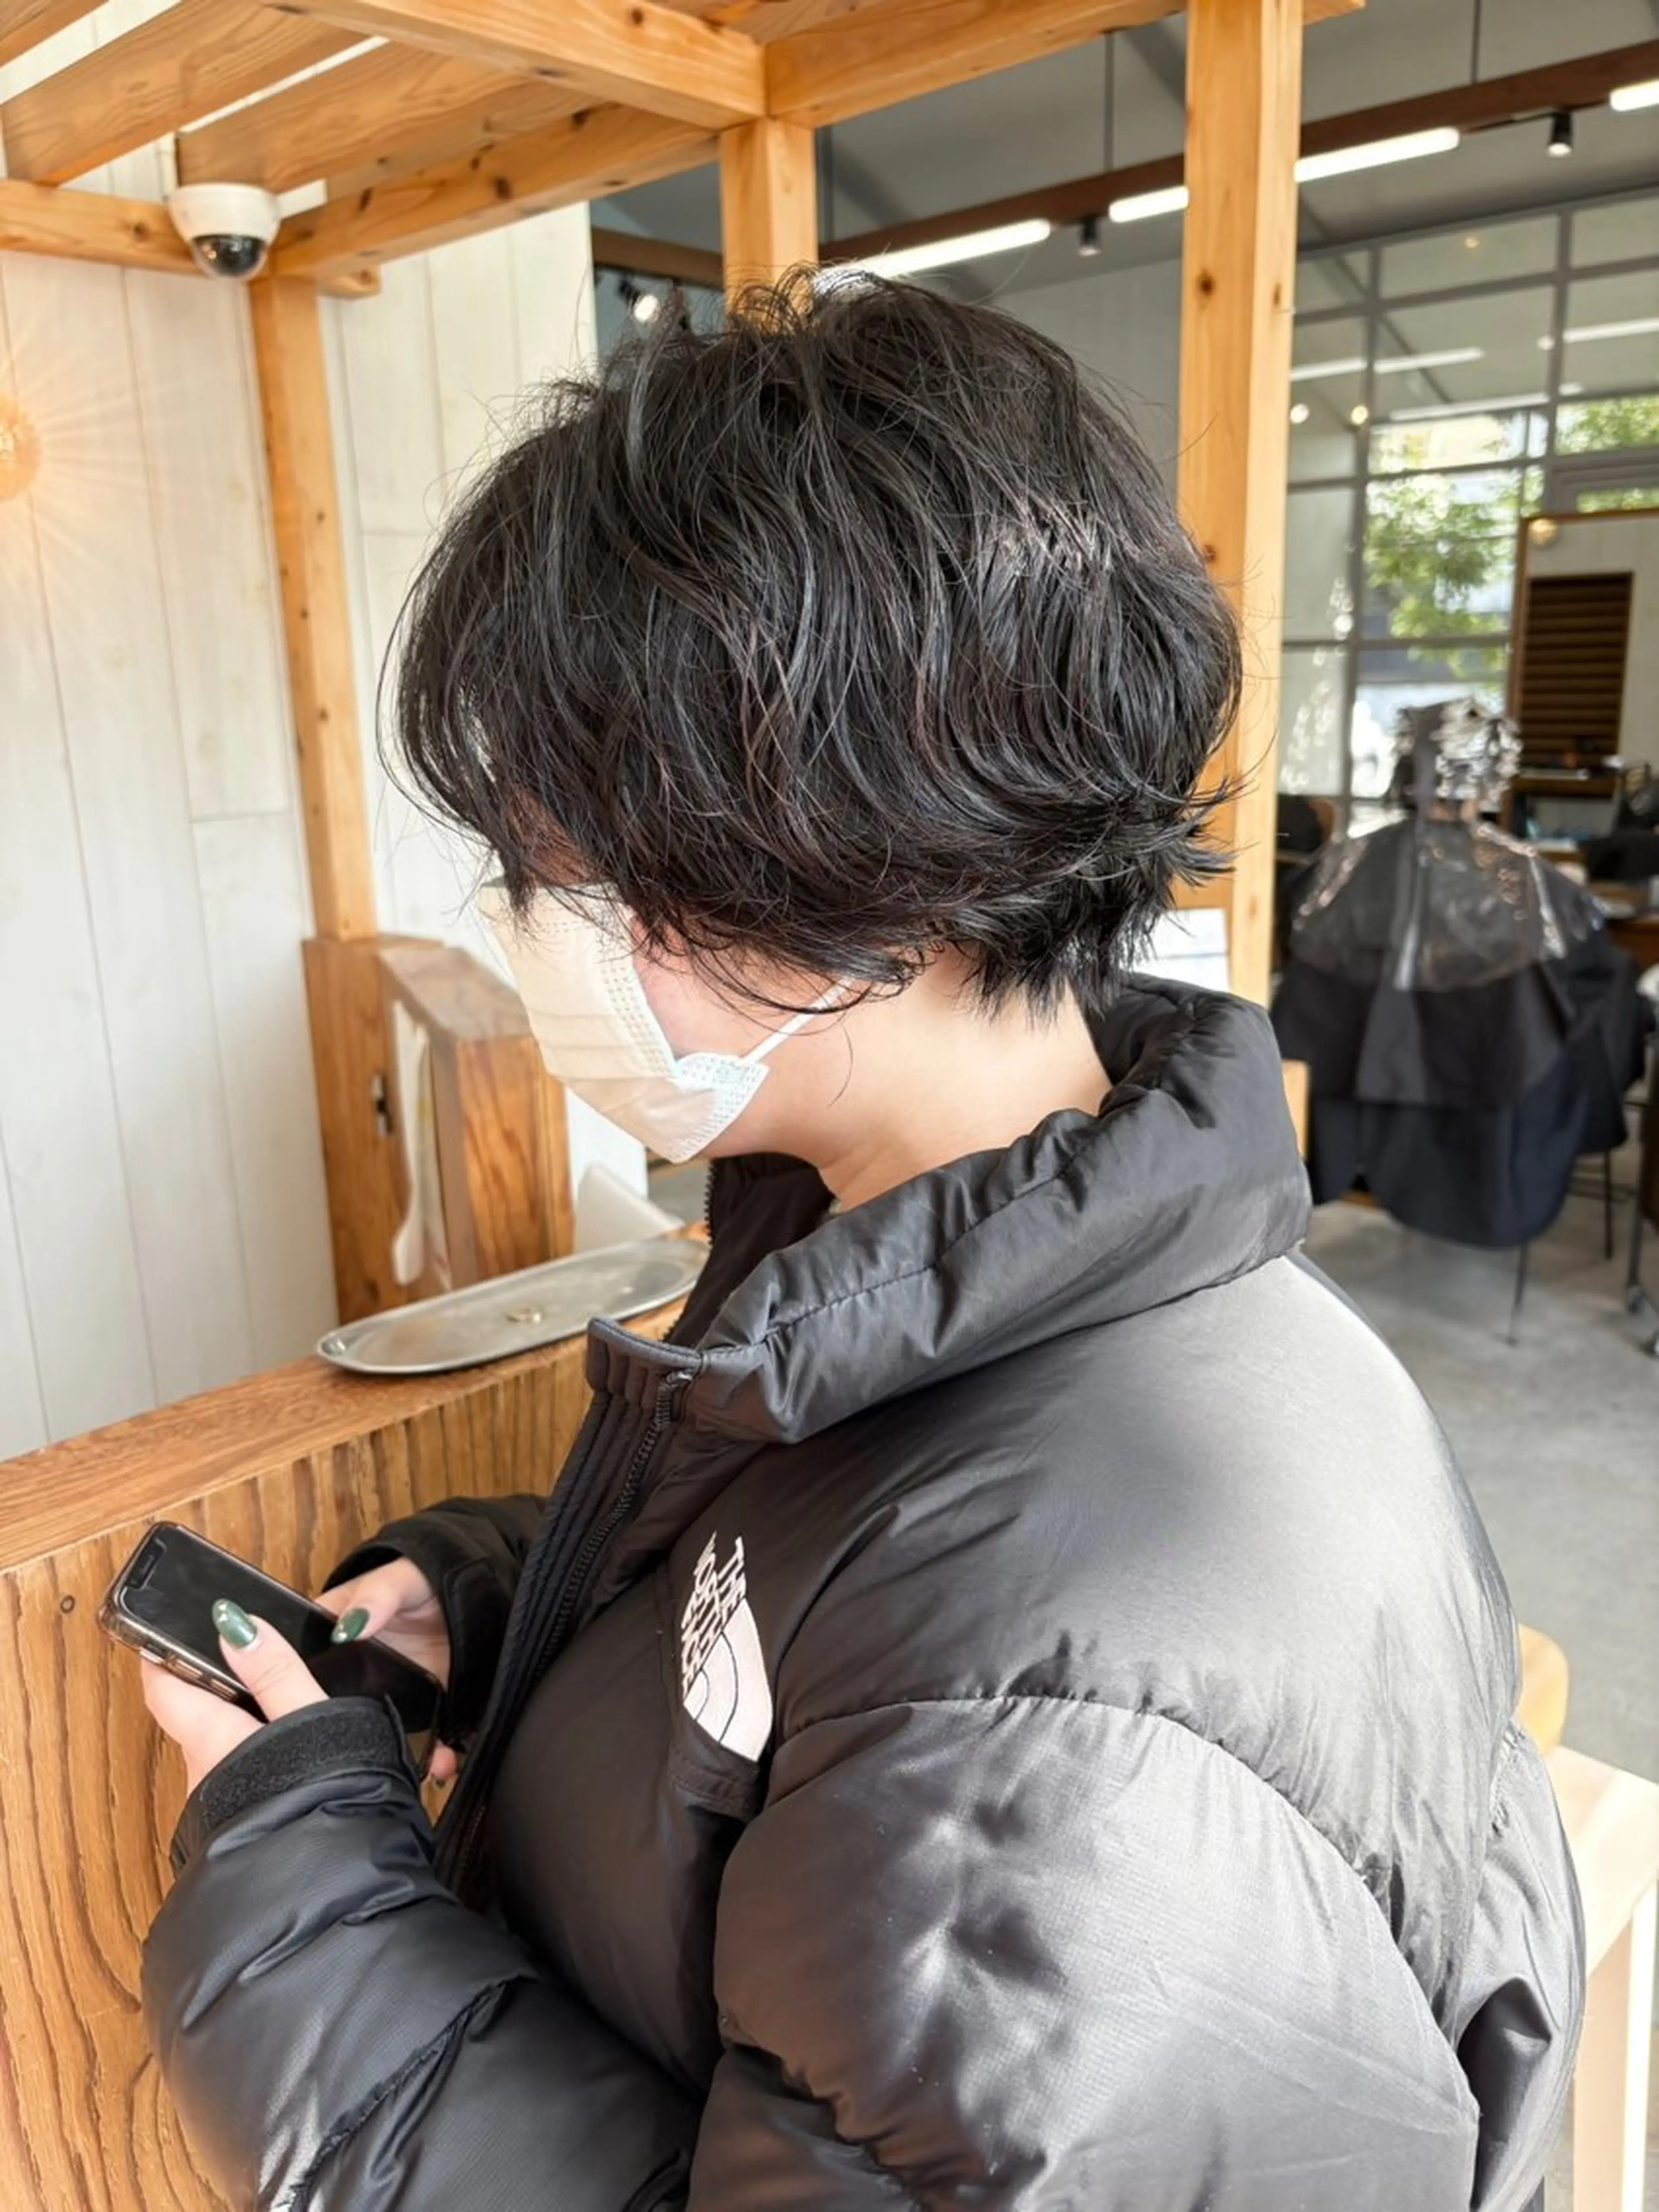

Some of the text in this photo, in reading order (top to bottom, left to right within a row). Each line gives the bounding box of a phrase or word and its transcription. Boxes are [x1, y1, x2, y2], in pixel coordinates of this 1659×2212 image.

[693, 1530, 722, 1660] NORTH
[718, 1536, 746, 1623] THE
[681, 1591, 701, 1698] FACE
